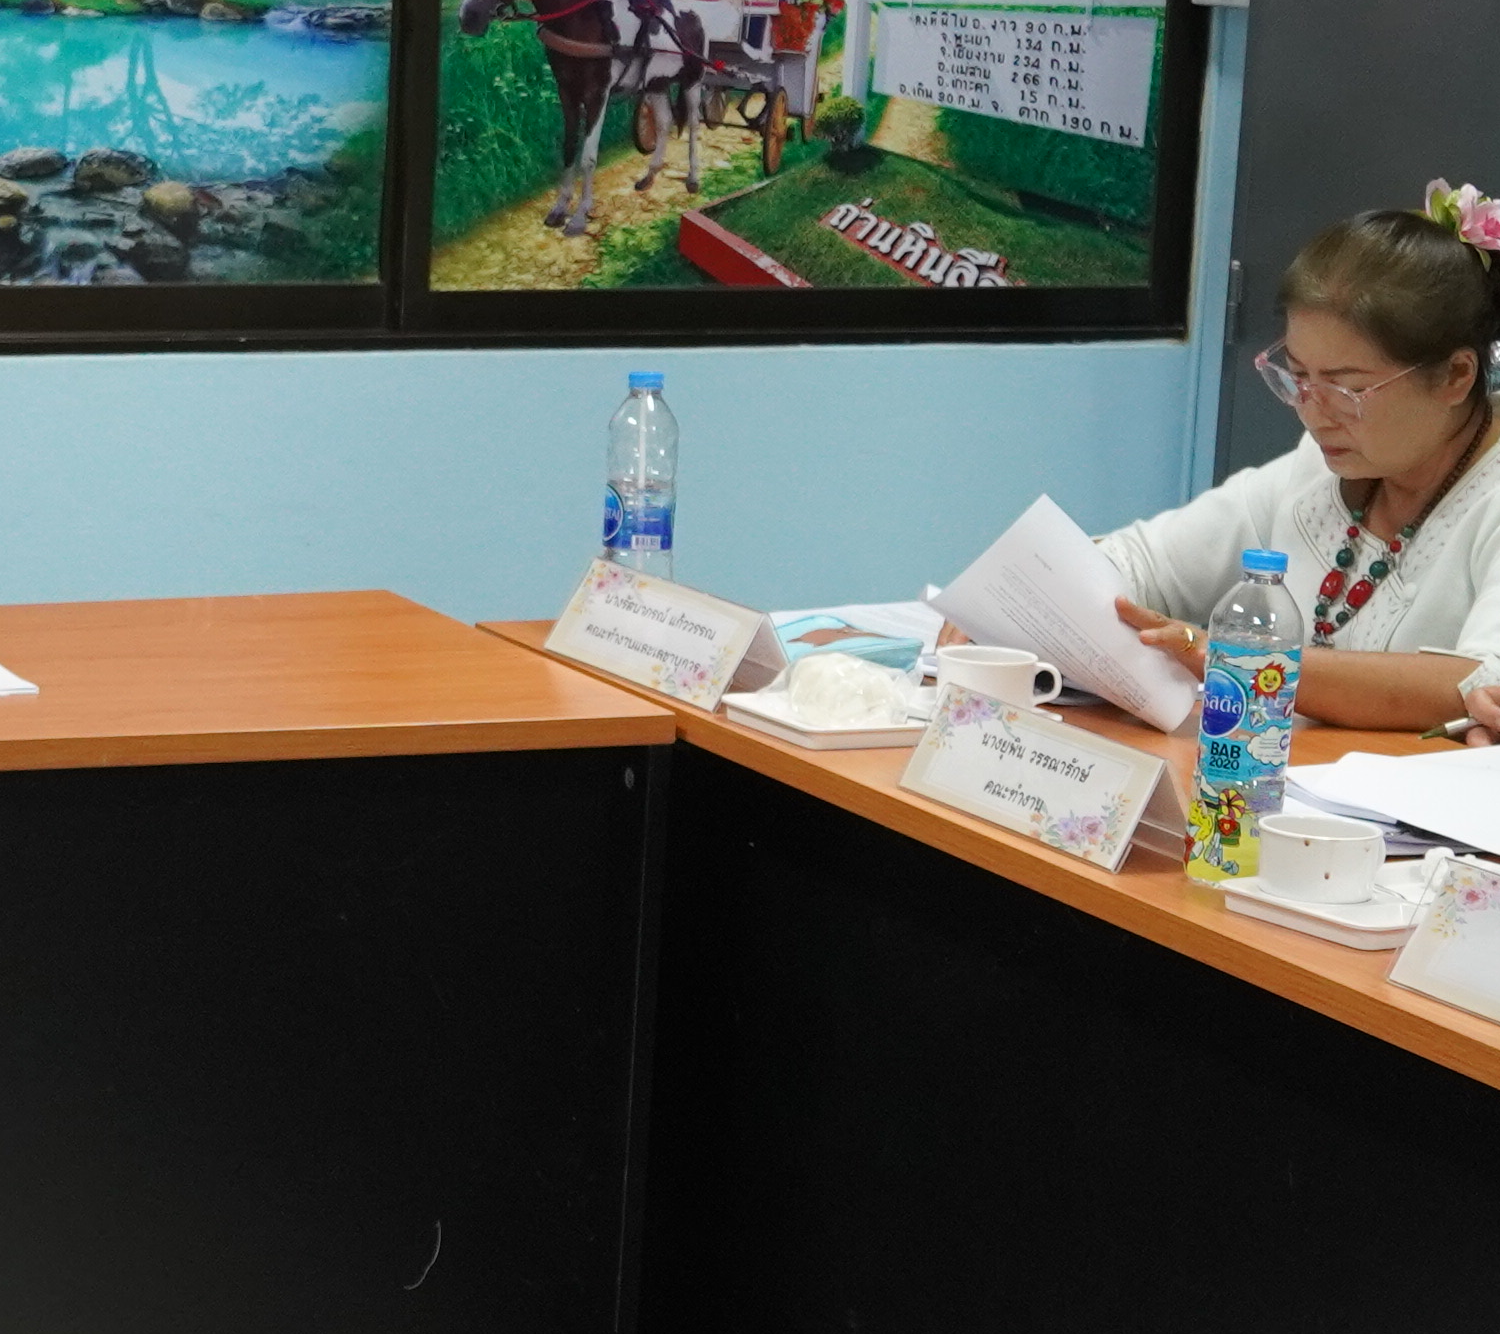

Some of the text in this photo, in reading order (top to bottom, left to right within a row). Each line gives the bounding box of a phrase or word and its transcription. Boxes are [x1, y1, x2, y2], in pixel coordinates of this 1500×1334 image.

[981, 731, 1096, 784] นางยุพิน วรรณารักษ์
[1210, 741, 1241, 759] BAB
[1209, 756, 1240, 772] 2020
[982, 779, 1045, 814] คณะทำงาน
